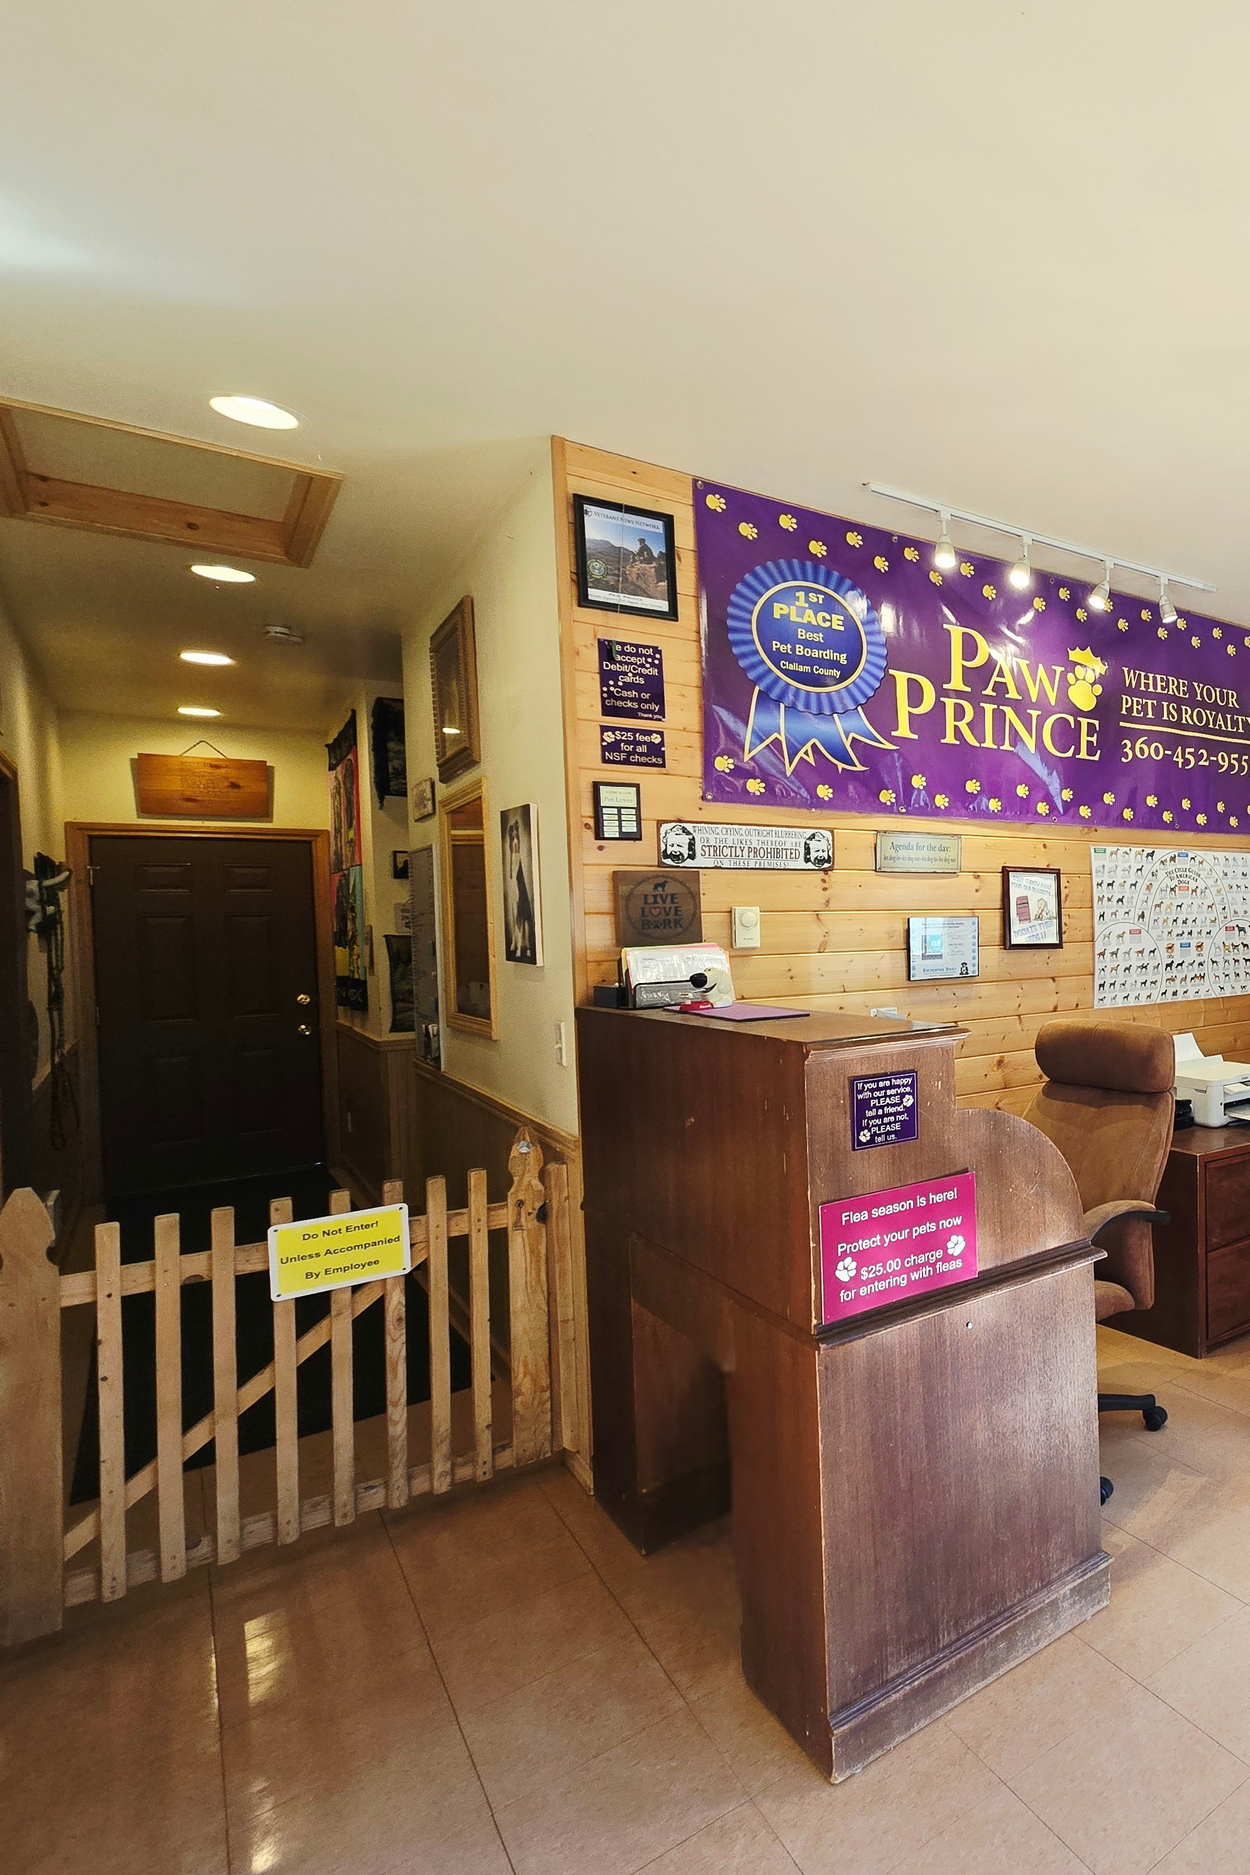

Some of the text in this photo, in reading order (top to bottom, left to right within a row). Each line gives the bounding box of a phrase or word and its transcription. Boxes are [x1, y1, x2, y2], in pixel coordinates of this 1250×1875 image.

[635, 520, 660, 530] NETWORK
[773, 602, 844, 631] PLACE
[797, 628, 824, 642] Best
[624, 644, 636, 653] do
[638, 647, 654, 656] not
[772, 640, 847, 664] Pet Boarding
[616, 654, 646, 665] accept
[942, 623, 1065, 706] PAW
[603, 661, 658, 676] Debit/Credit
[780, 660, 840, 678] Clallam County
[618, 675, 644, 684] cards
[614, 688, 638, 698] Cash
[1122, 666, 1239, 708] WHERE YOUR
[605, 698, 660, 712] checks only
[1120, 694, 1156, 718] PET
[1162, 701, 1178, 722] IS
[888, 669, 1101, 761] PRINCE
[614, 730, 650, 742] $25 fee
[620, 742, 647, 753] for all
[605, 751, 662, 764] NSF checks
[744, 828, 774, 838] OUTRIGHT
[700, 836, 710, 844] OR
[732, 838, 752, 846] LIKES
[756, 839, 787, 847] THEREOF
[890, 842, 951, 855] Agenda for the day:
[701, 844, 800, 860] STRICTLY PROHIBITED
[643, 893, 679, 905] LIVE
[864, 1082, 877, 1091] you
[879, 1080, 890, 1088] are
[891, 1077, 913, 1086] happy
[857, 1092, 872, 1100] with
[870, 1095, 901, 1107] PLEASE
[866, 1109, 876, 1117] tell
[884, 1105, 905, 1114] friend.
[869, 1119, 882, 1127] you
[871, 1123, 901, 1134] PLEASE
[875, 1134, 885, 1143] tell
[842, 1187, 958, 1226] Flea season is here!
[302, 1220, 379, 1241] Do Not Enter!
[837, 1215, 962, 1256] Protect your pets now
[280, 1235, 400, 1265] Unless Accompanied
[305, 1259, 380, 1280] By Employee
[860, 1249, 943, 1281] $25.00 charge
[839, 1258, 962, 1302] for entering with fleas
